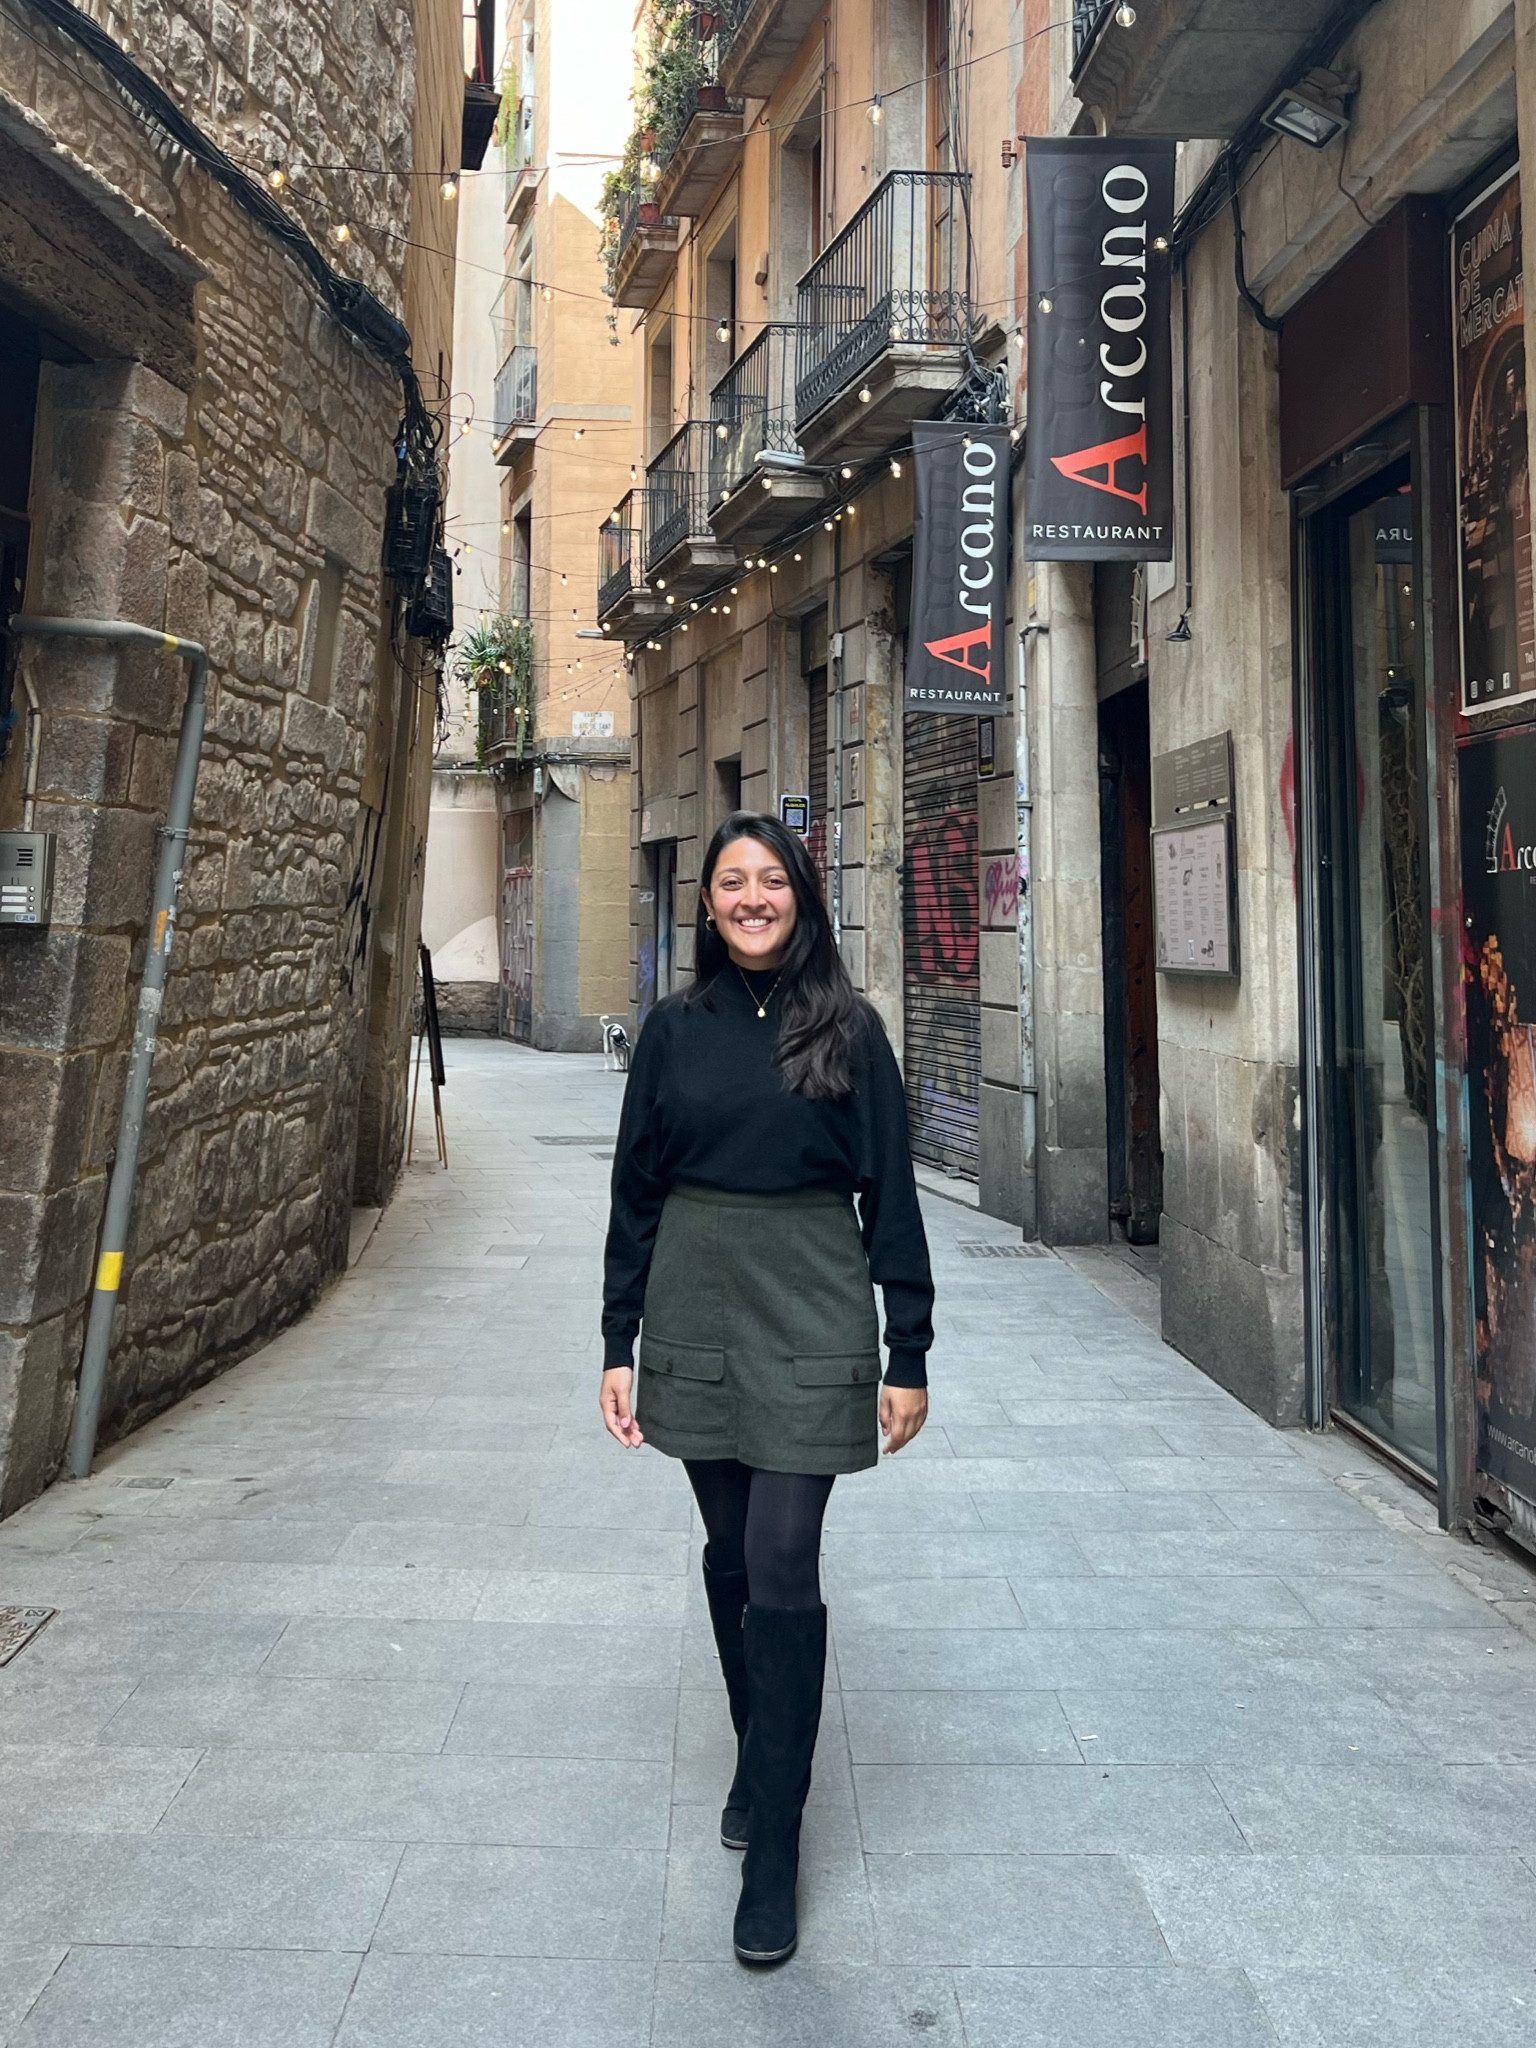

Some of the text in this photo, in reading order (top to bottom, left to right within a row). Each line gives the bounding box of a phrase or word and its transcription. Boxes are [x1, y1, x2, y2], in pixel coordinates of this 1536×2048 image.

[1459, 211, 1513, 277] CUINA
[1459, 268, 1481, 313] DE
[1050, 164, 1149, 515] Arcano
[1032, 524, 1163, 540] RESTAURANT
[923, 442, 996, 685] Arcano
[909, 688, 1001, 702] RESTAURANT
